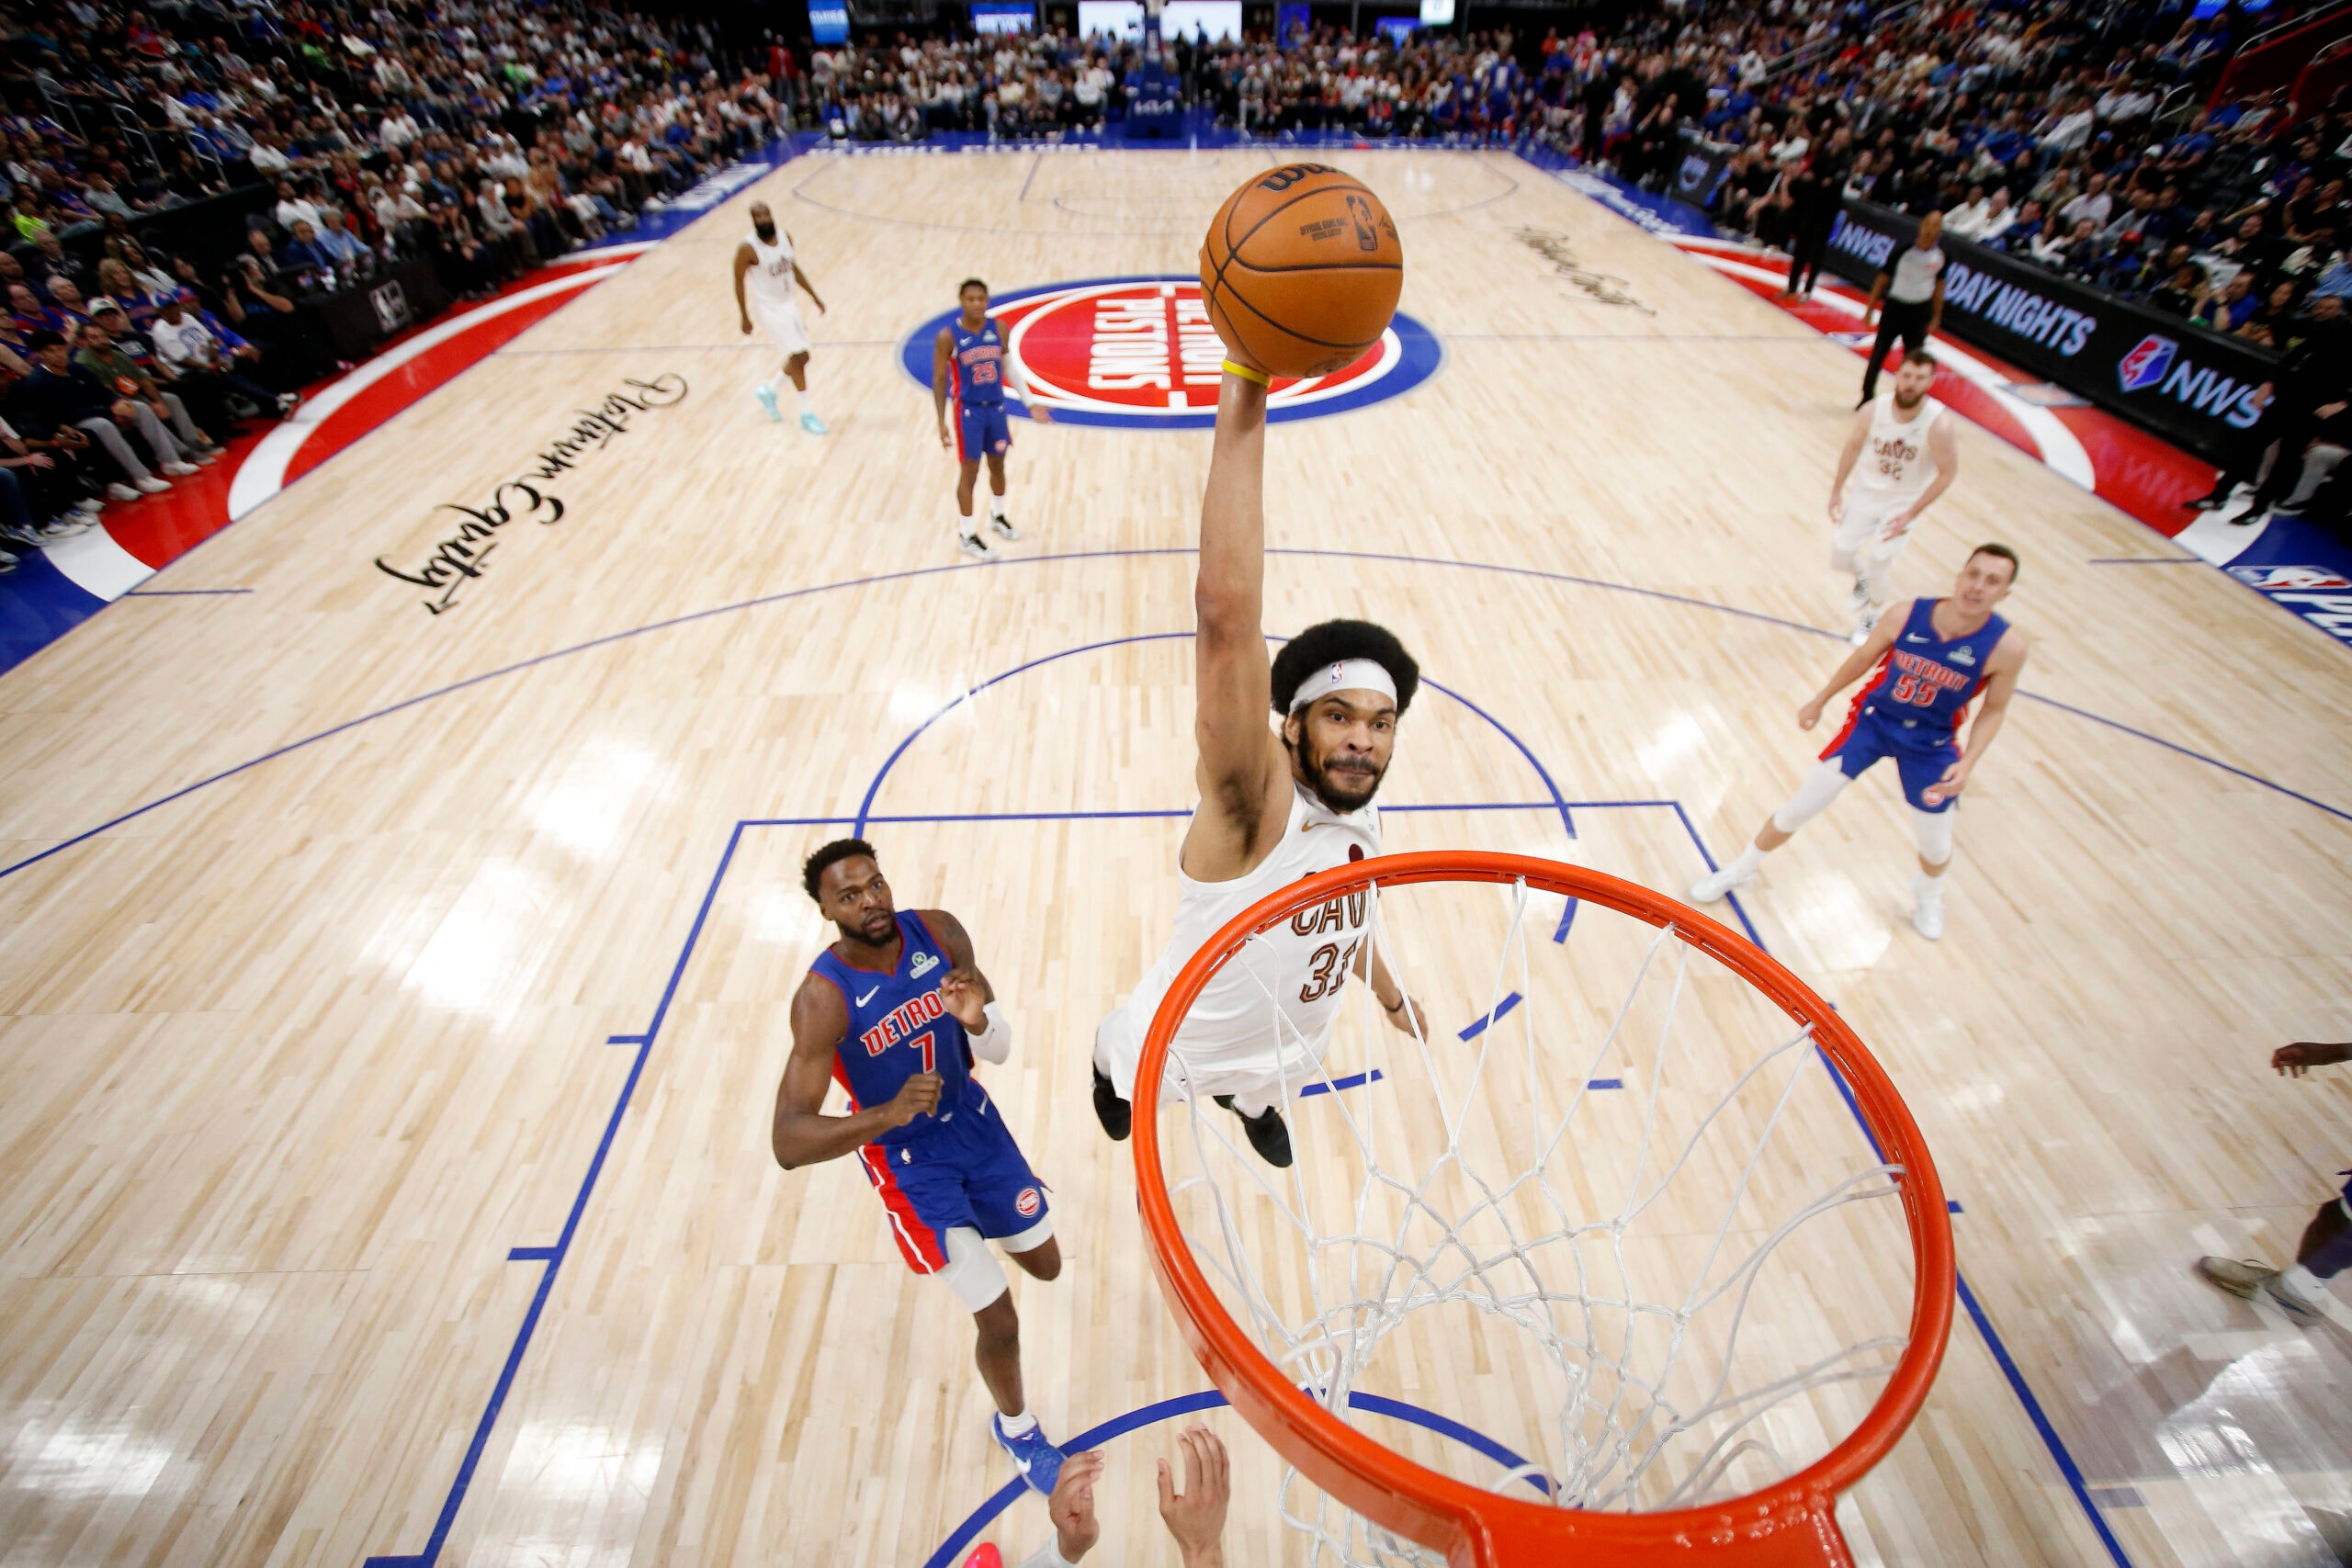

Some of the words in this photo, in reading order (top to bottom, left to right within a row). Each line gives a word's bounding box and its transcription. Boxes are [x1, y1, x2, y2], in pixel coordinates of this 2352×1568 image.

[1088, 297, 1171, 389] PISTONS
[1945, 261, 2003, 314] DAY
[1984, 277, 2098, 357] NIGHTS
[972, 360, 999, 385] 25
[2160, 359, 2276, 429] NWS
[527, 372, 688, 479] Platinum
[374, 480, 564, 615] Equity
[1890, 671, 1943, 708] 55
[1894, 648, 1971, 693] DETROIT
[1291, 874, 1377, 937] CAV
[1299, 935, 1360, 1004] 31
[859, 988, 948, 1057] DETRO
[909, 1030, 935, 1074] 7
